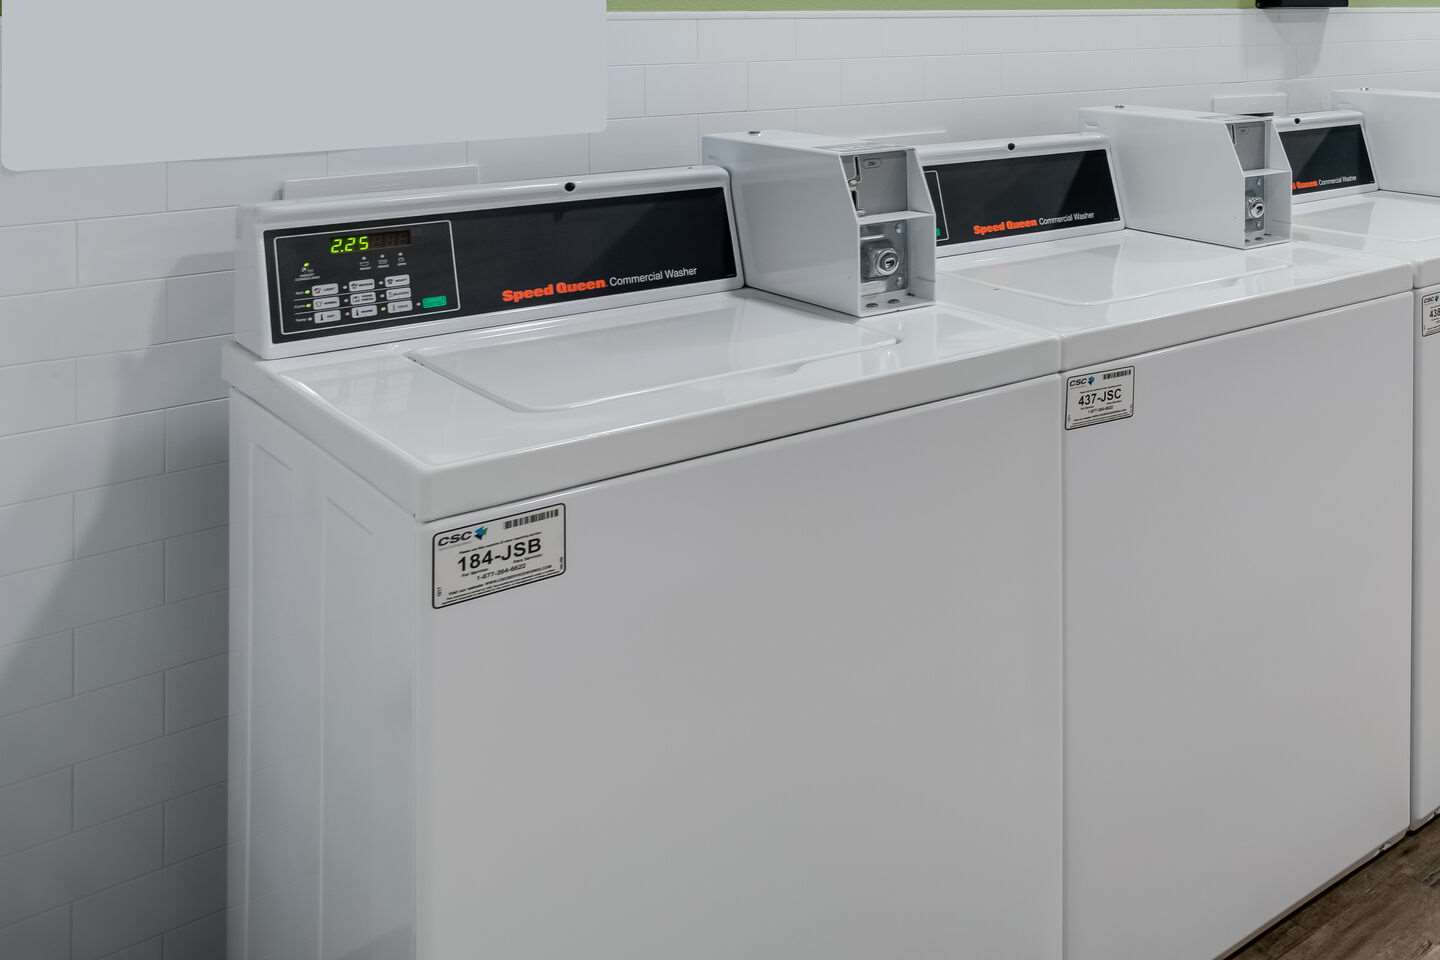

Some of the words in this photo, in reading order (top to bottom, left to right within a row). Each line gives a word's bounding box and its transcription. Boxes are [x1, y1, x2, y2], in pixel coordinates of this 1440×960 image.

[973, 221, 1006, 235] Speed
[1006, 219, 1038, 230] Queen
[1039, 213, 1073, 225] Commercial
[1073, 211, 1095, 220] Washer
[330, 235, 369, 254] 2.25
[502, 284, 554, 302] Speed
[556, 279, 606, 294] Queen
[609, 270, 663, 287] Commercial
[664, 266, 698, 280] Washer
[1069, 377, 1088, 387] CSC
[1078, 388, 1122, 406] 437-JSC
[437, 530, 473, 547] CSC
[457, 537, 542, 572] 184-JSB
